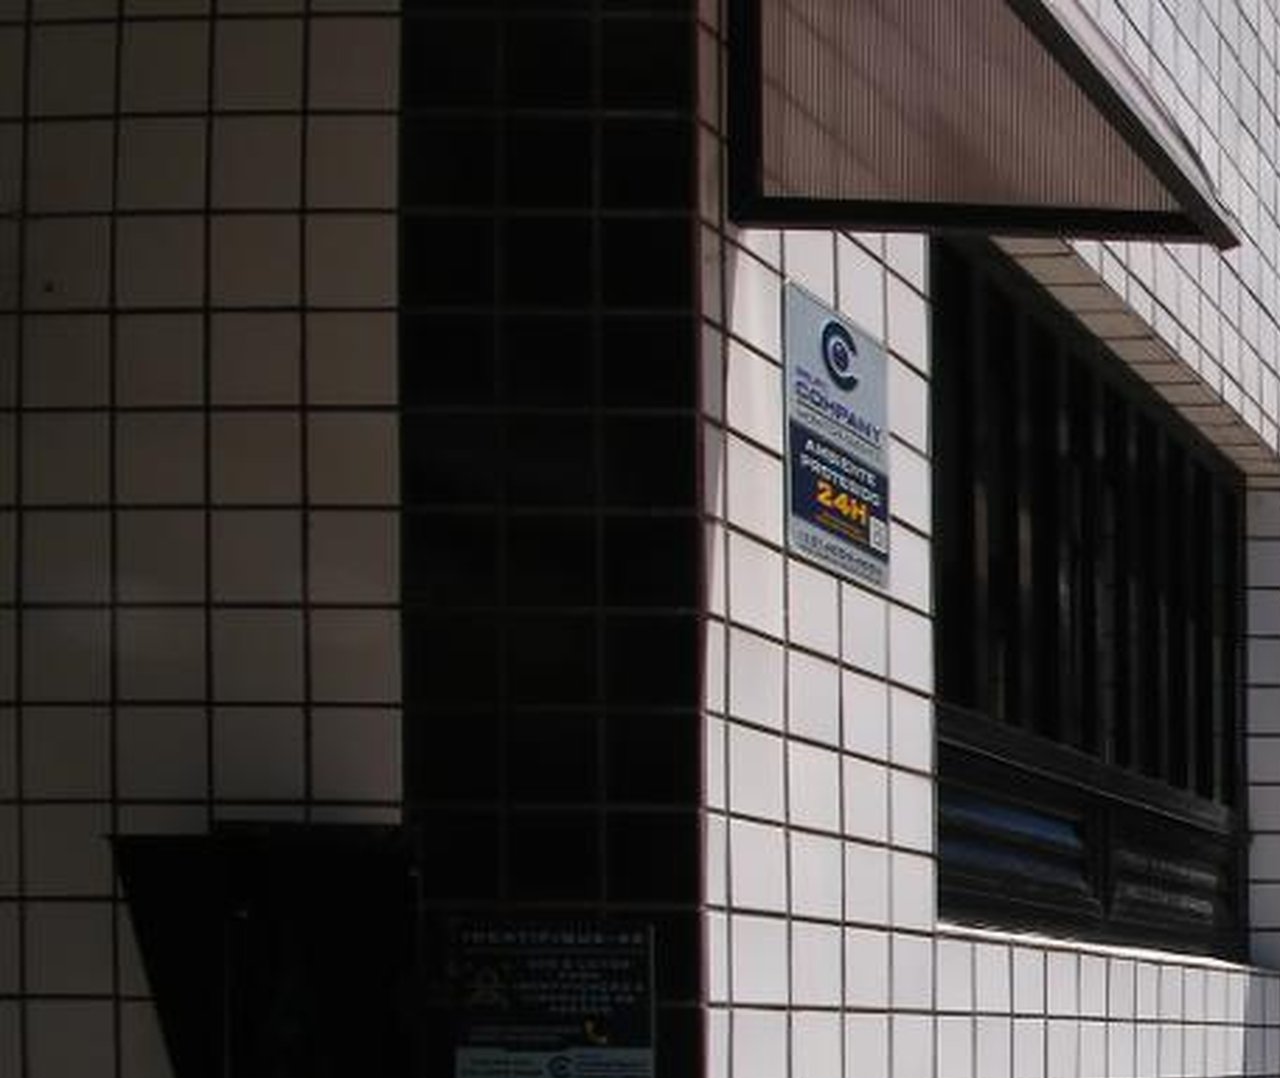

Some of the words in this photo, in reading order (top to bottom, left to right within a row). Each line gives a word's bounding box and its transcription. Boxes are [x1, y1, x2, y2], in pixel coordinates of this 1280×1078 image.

[796, 381, 881, 443] COMPANY
[801, 454, 881, 506] PROTEGIDO
[805, 439, 877, 487] AMBIENTE
[816, 481, 868, 525] 24H
